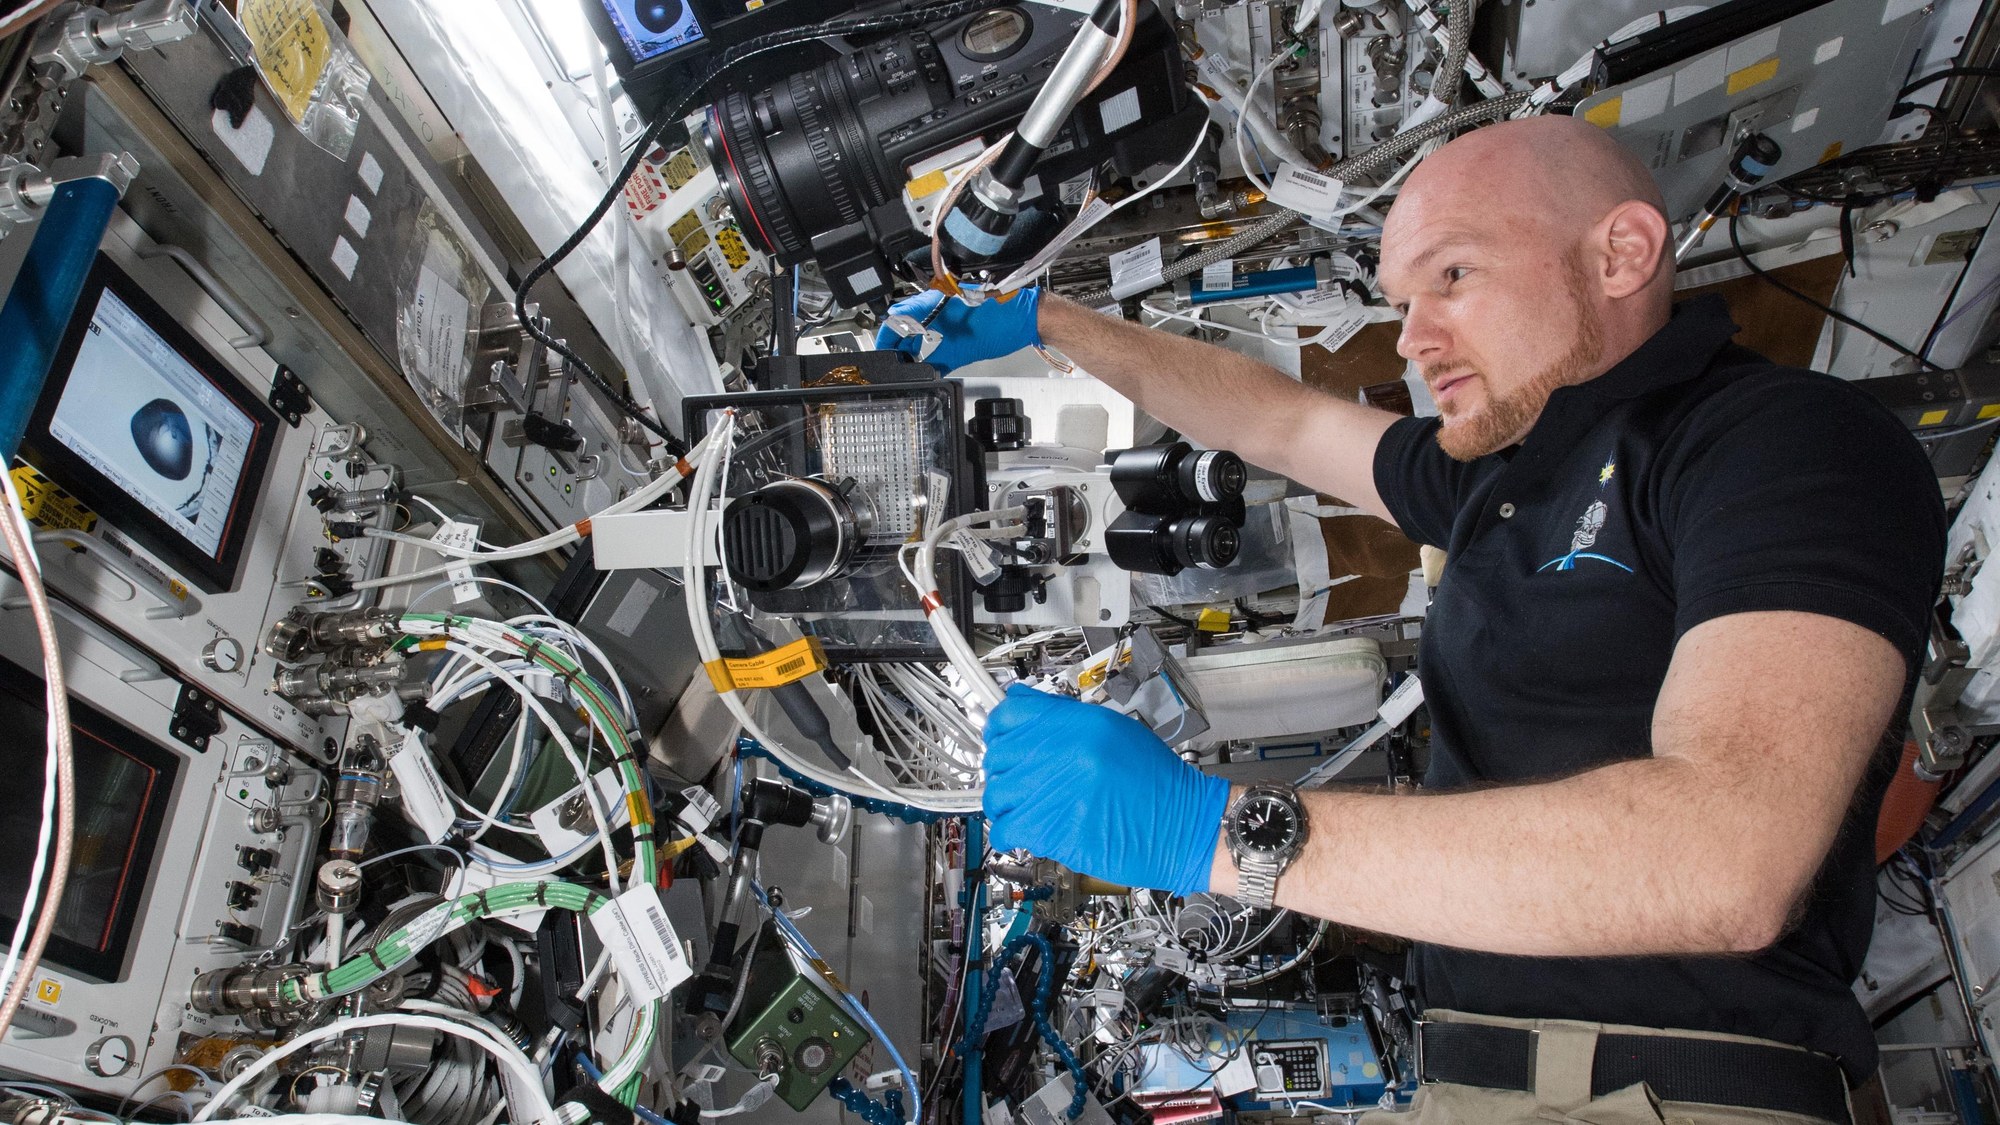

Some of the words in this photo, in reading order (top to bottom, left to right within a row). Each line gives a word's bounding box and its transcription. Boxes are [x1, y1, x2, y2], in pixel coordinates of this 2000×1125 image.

[640, 188, 652, 204] FIRE
[461, 527, 469, 542] SABL
[969, 547, 985, 570] Camera
[728, 660, 747, 669] Camera
[749, 659, 765, 667] Cable
[270, 710, 283, 721] MTL
[271, 703, 286, 716] INLET
[296, 719, 315, 736] OUTLET
[298, 728, 310, 739] MTL
[248, 746, 260, 756] OFF
[617, 919, 630, 937] Cable
[624, 935, 636, 949] Data
[630, 948, 642, 963] Rack
[637, 961, 657, 990] EXPRESS
[801, 992, 817, 1006] CIRCUIT
[805, 988, 820, 1002] OUTPUT
[796, 996, 814, 1011] BREAKER
[89, 1014, 118, 1028] UNLOCKED
[192, 1015, 207, 1025] DATA
[828, 1013, 843, 1027] OUTPUT
[841, 1025, 855, 1037] POWER
[777, 1024, 792, 1037] OUTPUT
